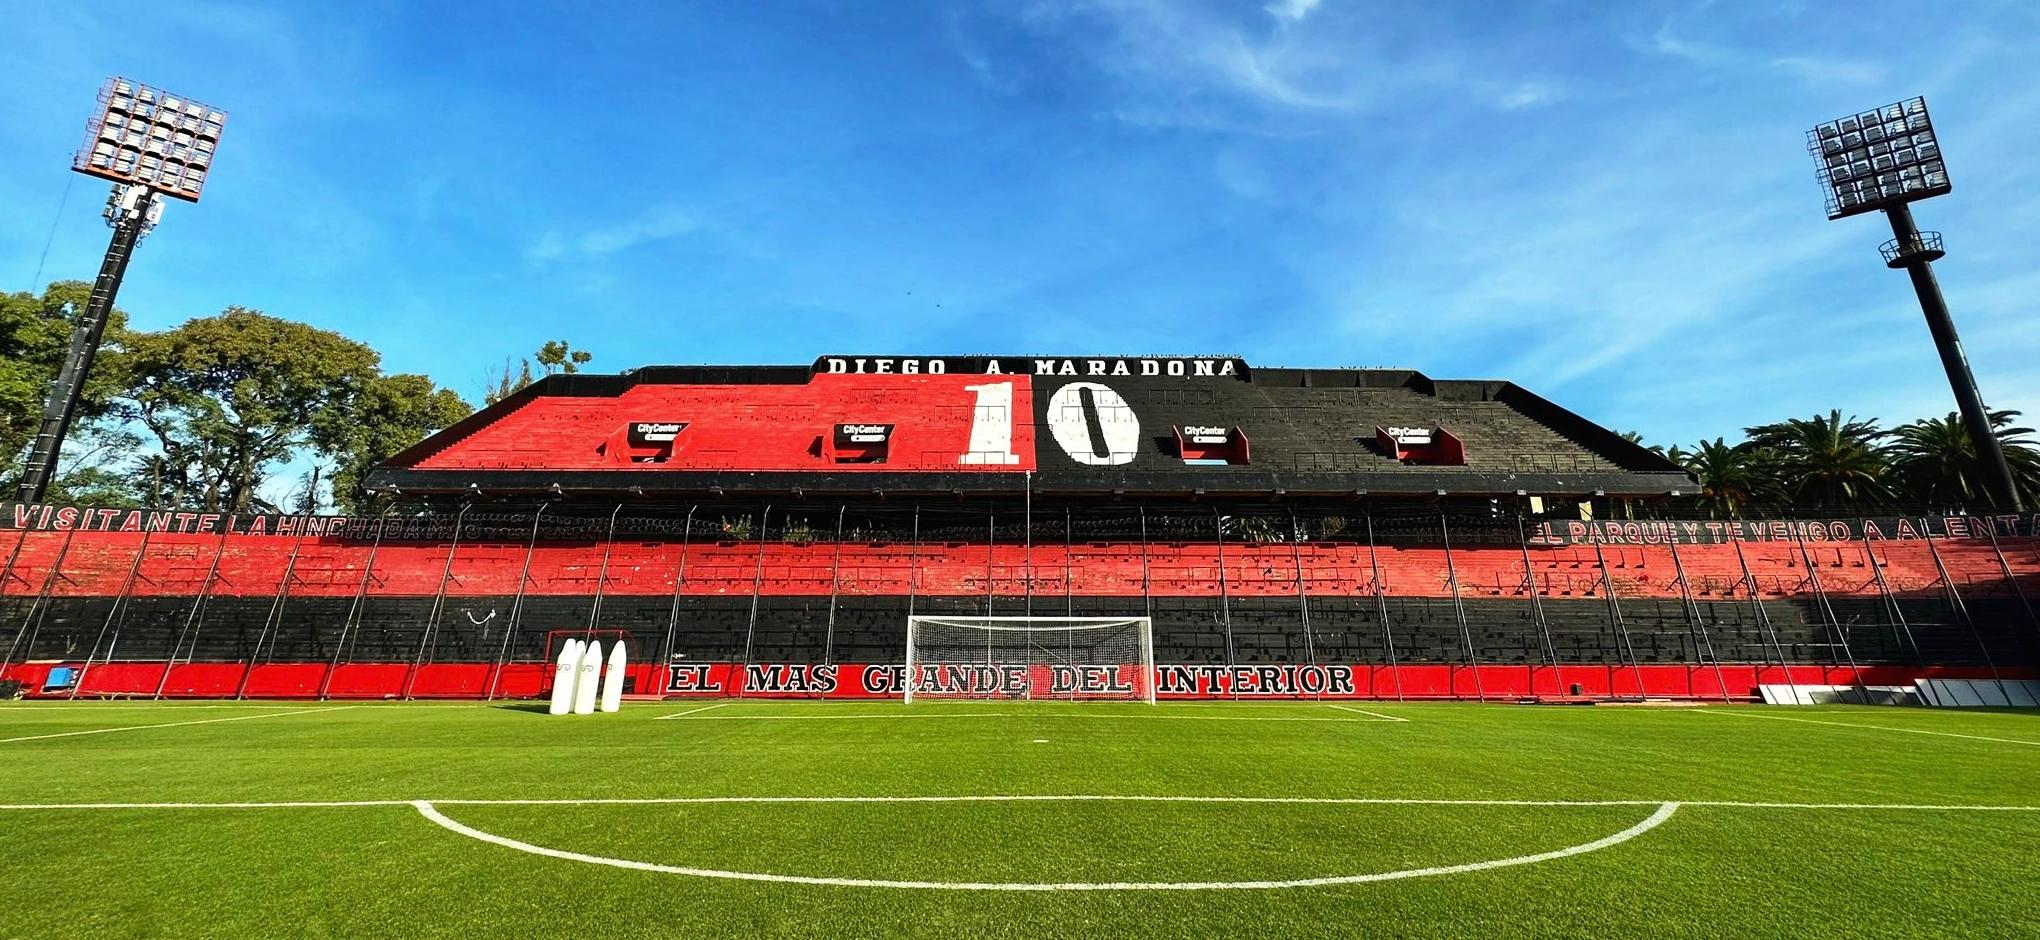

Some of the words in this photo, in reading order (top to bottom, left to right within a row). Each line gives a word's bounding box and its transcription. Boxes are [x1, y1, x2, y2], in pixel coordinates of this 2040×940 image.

[827, 359, 945, 374] DIEGO
[985, 359, 1015, 374] A.
[1034, 359, 1239, 375] MARADONA
[958, 381, 1141, 466] 10
[14, 503, 221, 535] VISITANTE
[226, 514, 266, 536] LA
[275, 516, 418, 539] HINCHADA
[1528, 521, 1564, 543] EL
[1568, 521, 1680, 545] PARQUE
[1682, 522, 1698, 544] Y
[1705, 522, 1746, 544] TE
[1750, 520, 1851, 543] VENGO
[1863, 519, 1888, 541] A
[667, 663, 721, 693] EL
[744, 663, 839, 694] MAS
[862, 663, 1030, 694] GRANDE
[1052, 663, 1134, 694] DEL
[1157, 663, 1356, 694] INTERIOR
